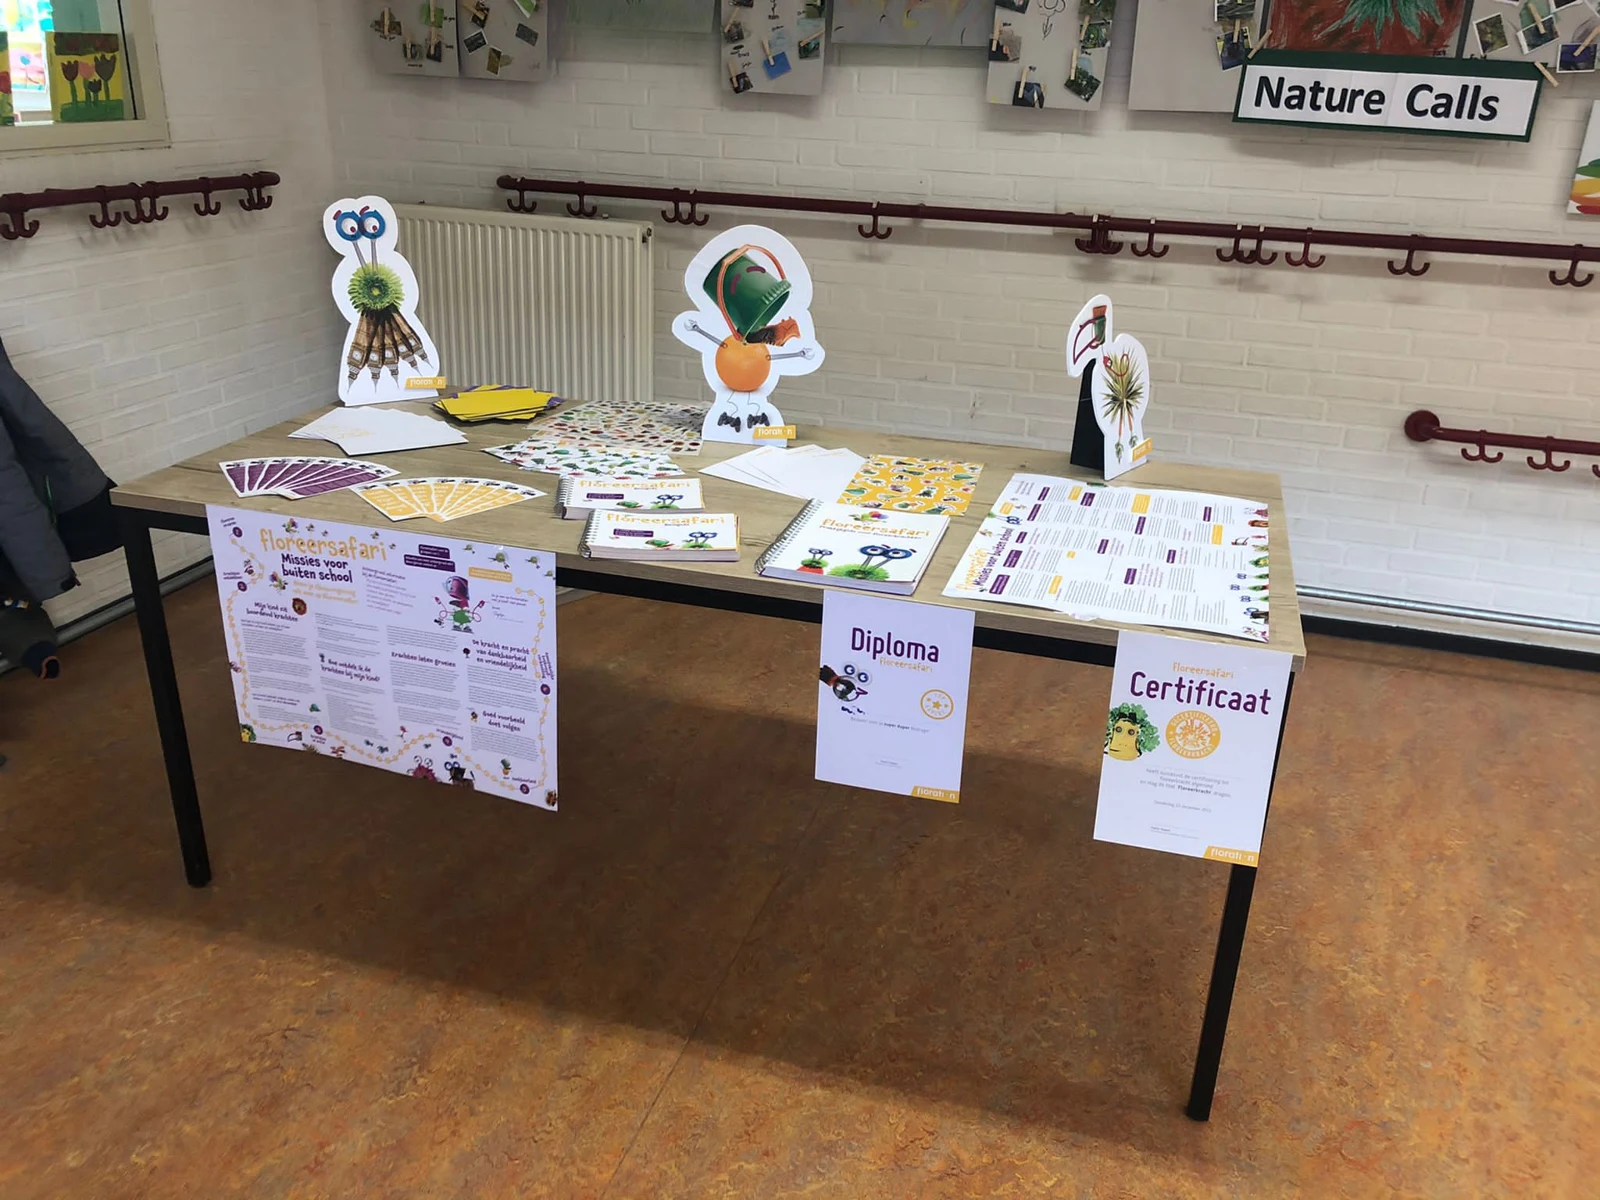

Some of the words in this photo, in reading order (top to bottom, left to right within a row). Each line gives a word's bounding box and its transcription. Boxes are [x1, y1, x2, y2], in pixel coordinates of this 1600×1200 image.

[1254, 75, 1386, 116] Nature
[1405, 83, 1500, 122] Calls
[606, 513, 725, 525] floreersafari
[822, 518, 931, 537] floreersafari
[260, 528, 387, 561] floreersafari
[281, 553, 321, 568] Missies
[323, 559, 349, 570] voor
[282, 565, 317, 580] buiten
[319, 569, 353, 583] school
[851, 627, 939, 663] Diploma
[1172, 662, 1235, 680] floreersafari
[1130, 671, 1271, 716] Certificaat
